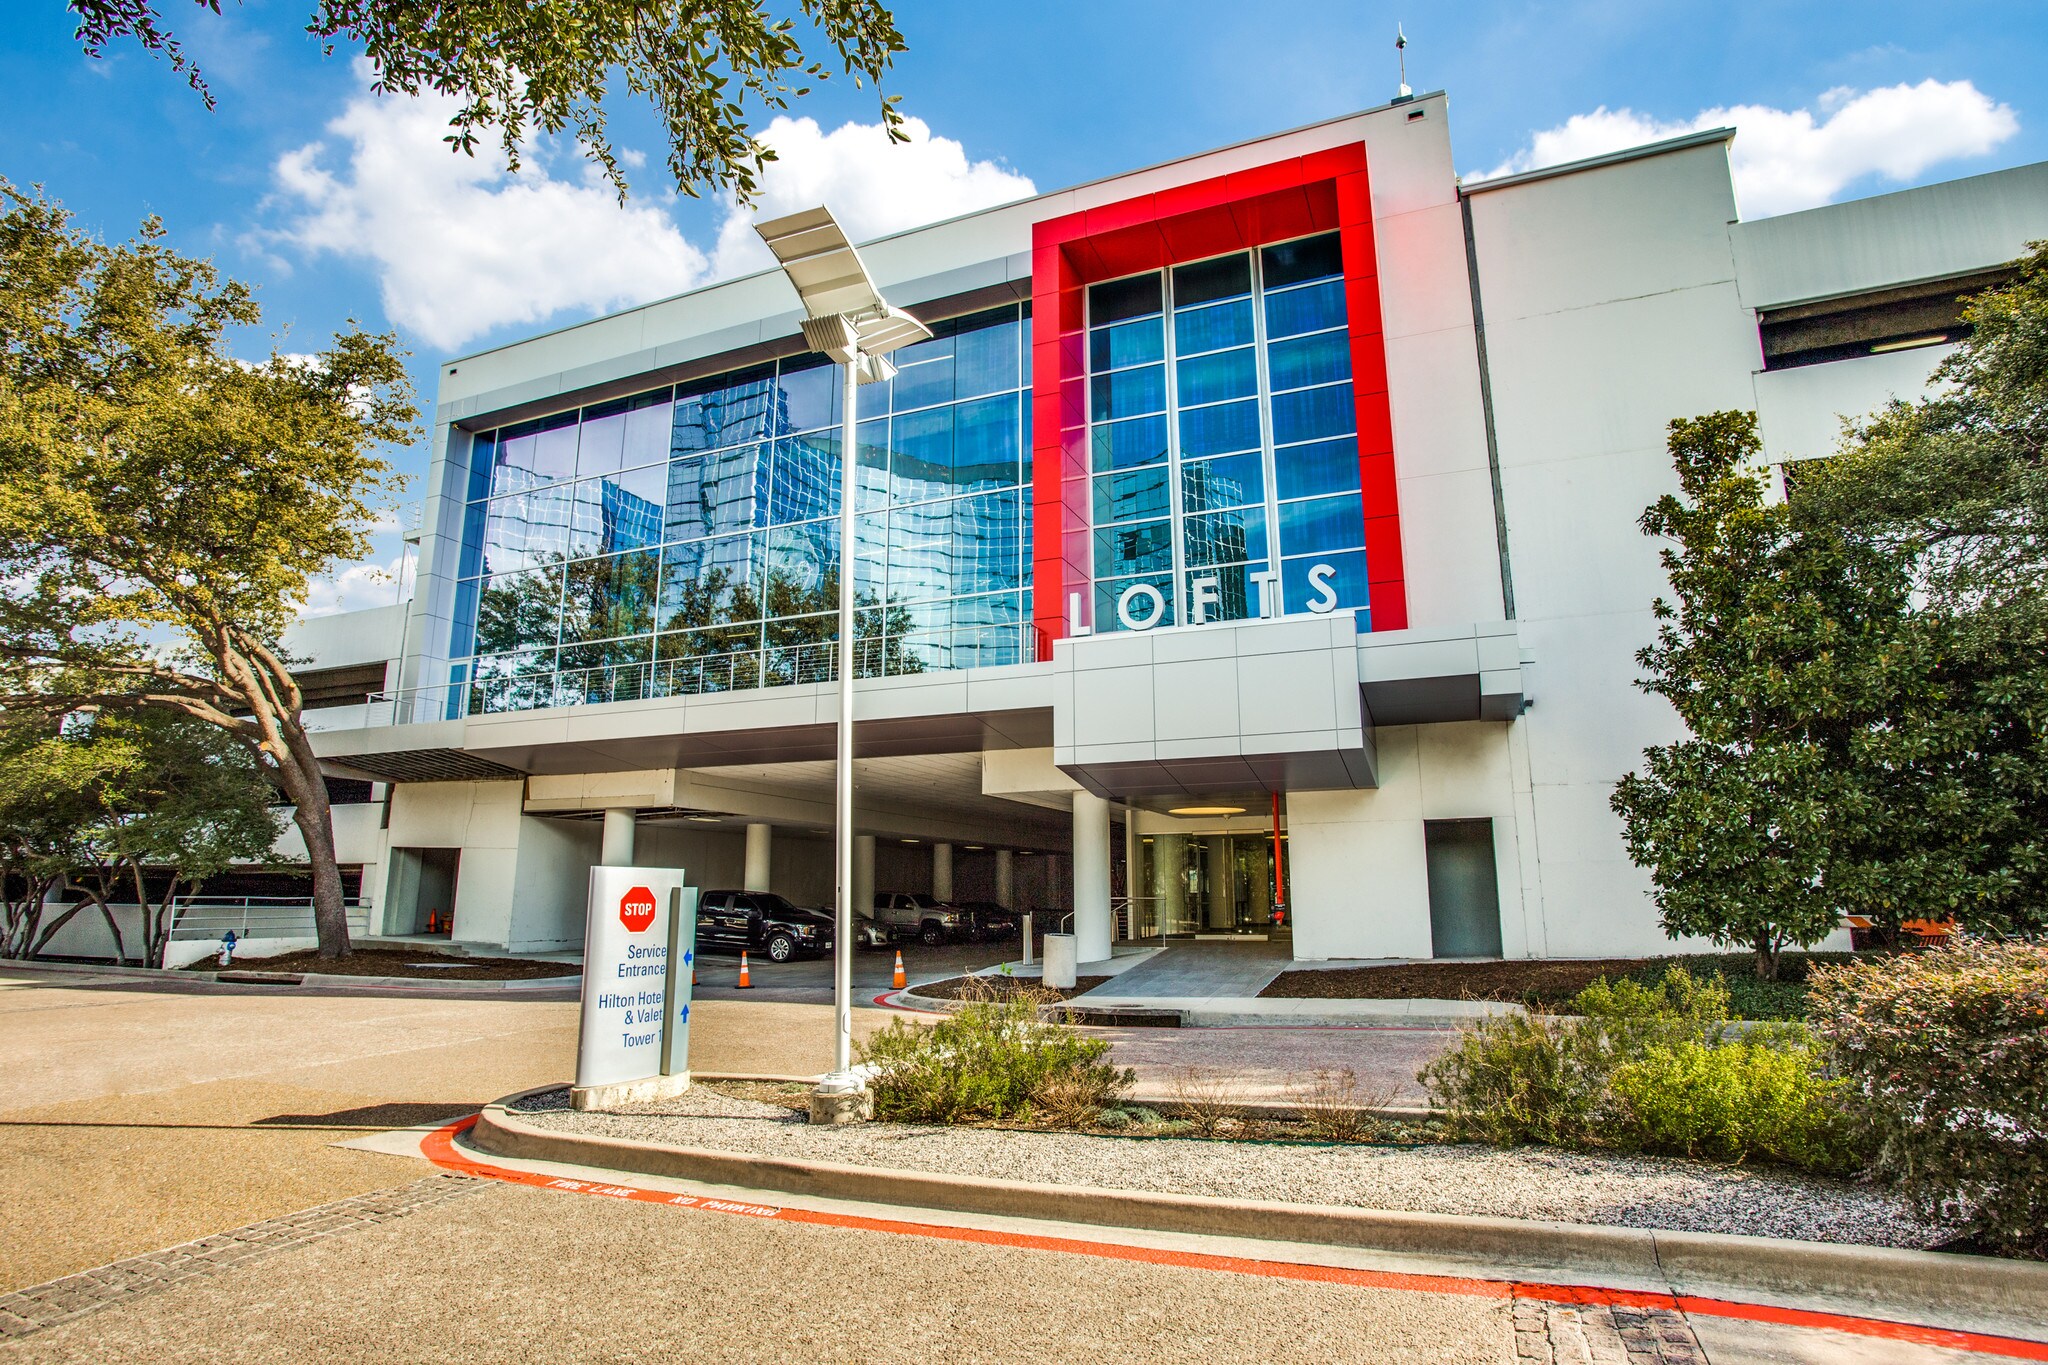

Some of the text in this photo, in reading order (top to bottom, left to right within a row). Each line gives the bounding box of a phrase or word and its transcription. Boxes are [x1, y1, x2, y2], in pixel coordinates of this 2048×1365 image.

[1069, 563, 1337, 637] LOFTS
[624, 903, 652, 916] STOP
[627, 943, 667, 960] Service
[618, 963, 666, 978] Entrance
[598, 989, 665, 1009] Hilton Hotel
[624, 1007, 663, 1025] & Valet
[622, 1029, 662, 1048] Tower 1
[546, 1179, 637, 1197] FIRE LANE
[668, 1196, 781, 1217] NO PARKING
